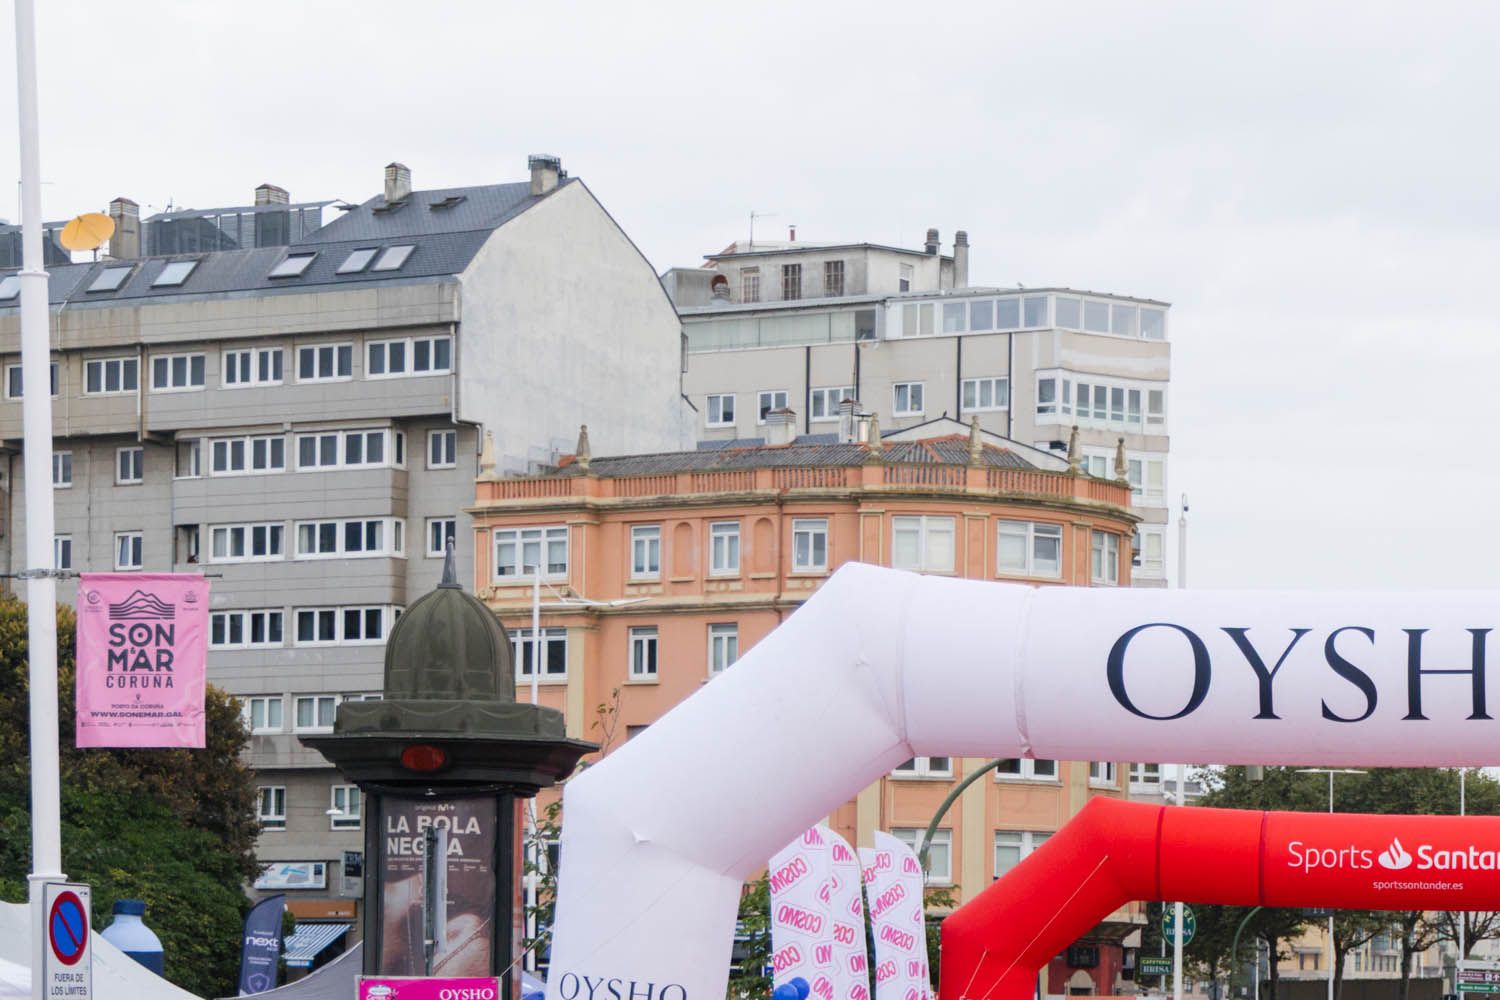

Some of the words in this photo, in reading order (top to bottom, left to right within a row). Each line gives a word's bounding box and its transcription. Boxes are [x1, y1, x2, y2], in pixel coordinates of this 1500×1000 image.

[108, 623, 175, 647] SON
[107, 649, 174, 672] MAR
[106, 672, 174, 689] CORUÑA
[387, 815, 410, 833] LA
[417, 815, 481, 834] BOLA
[387, 837, 464, 856] NEGA
[1287, 841, 1373, 874] Sports
[1373, 880, 1464, 891] sportssantander.es
[1164, 908, 1193, 924] HOEL
[246, 936, 279, 947] next
[54, 973, 74, 983] FUERA
[75, 974, 84, 983] DE
[51, 986, 63, 996] LOS
[64, 984, 87, 996] LÍMITES
[440, 988, 494, 1000] OYSHO
